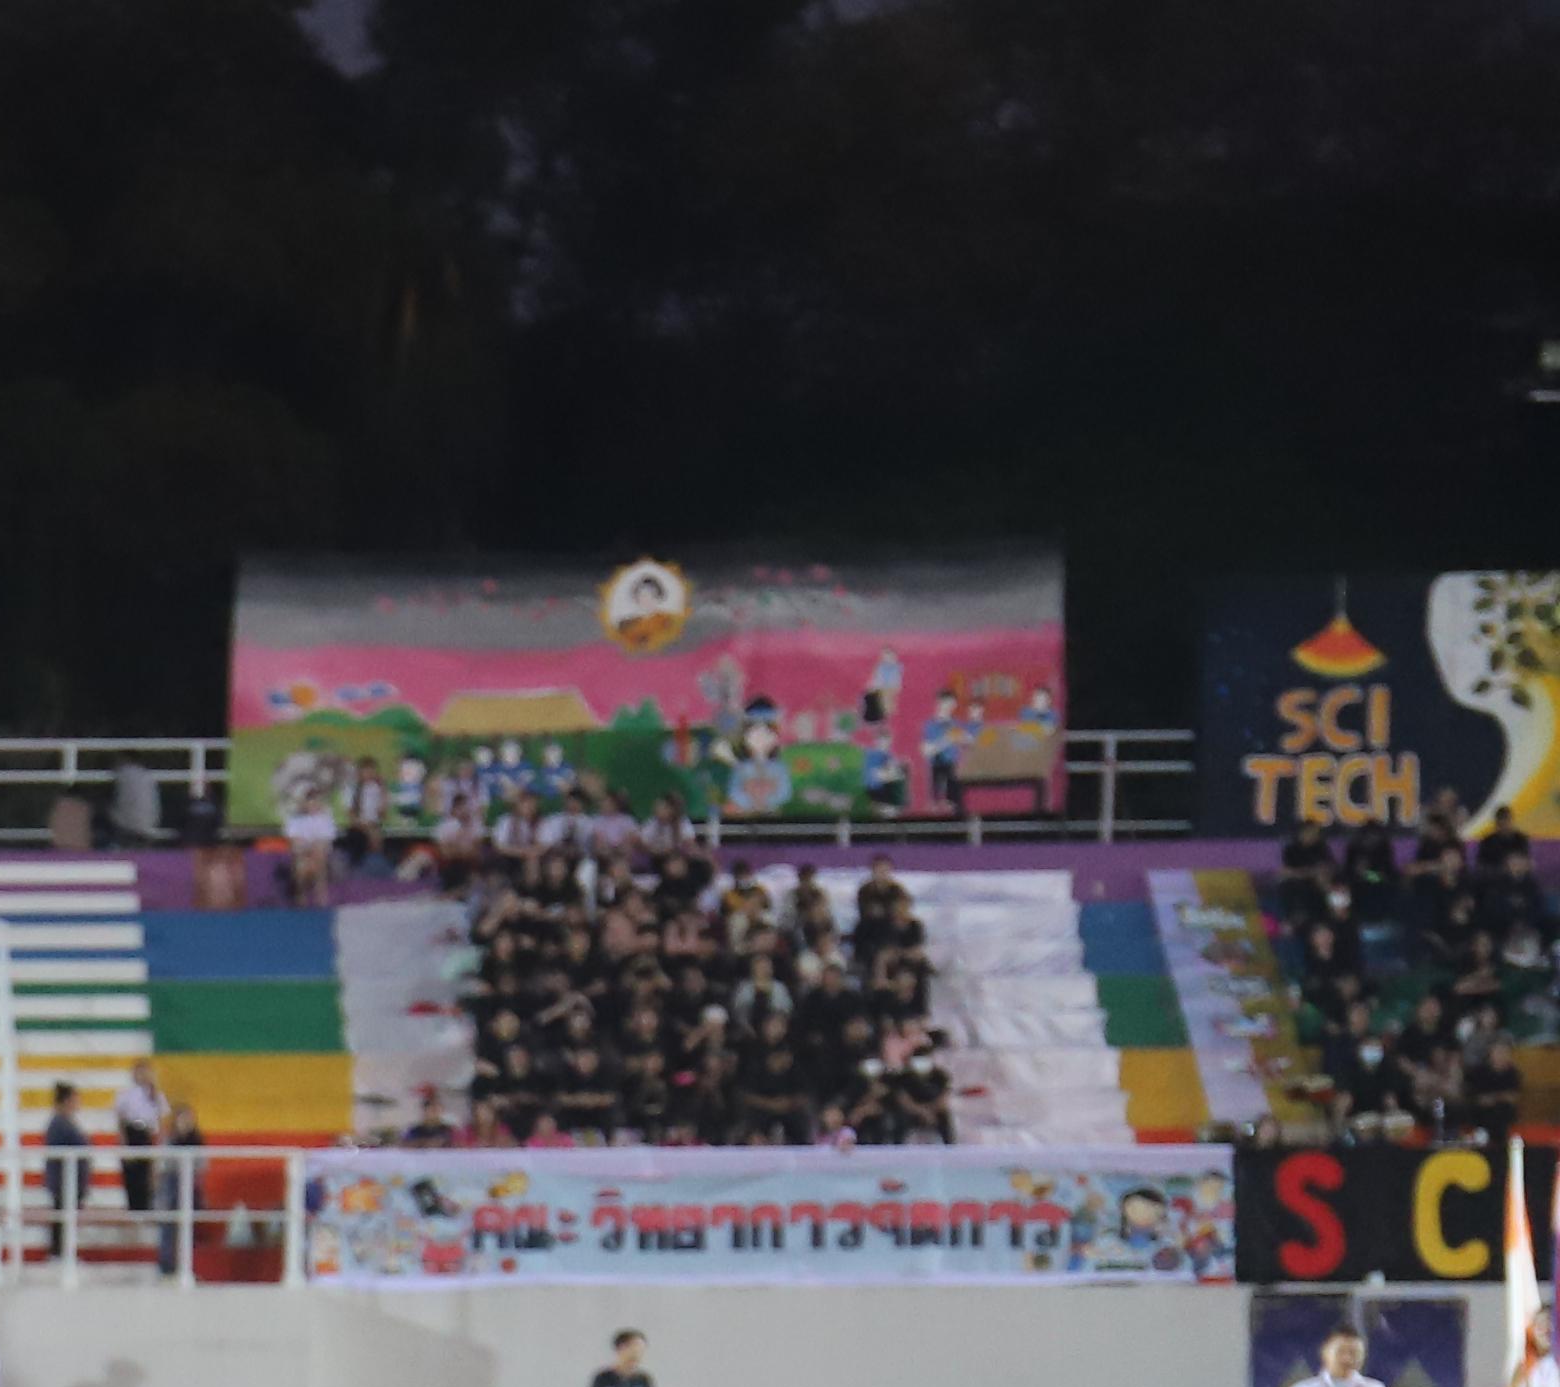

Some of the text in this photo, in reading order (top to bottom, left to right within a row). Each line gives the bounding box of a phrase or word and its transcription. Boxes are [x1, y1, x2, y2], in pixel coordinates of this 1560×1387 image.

[1275, 682, 1394, 752] SCI
[1240, 750, 1421, 827] TECH
[473, 1203, 579, 1252] คณะ
